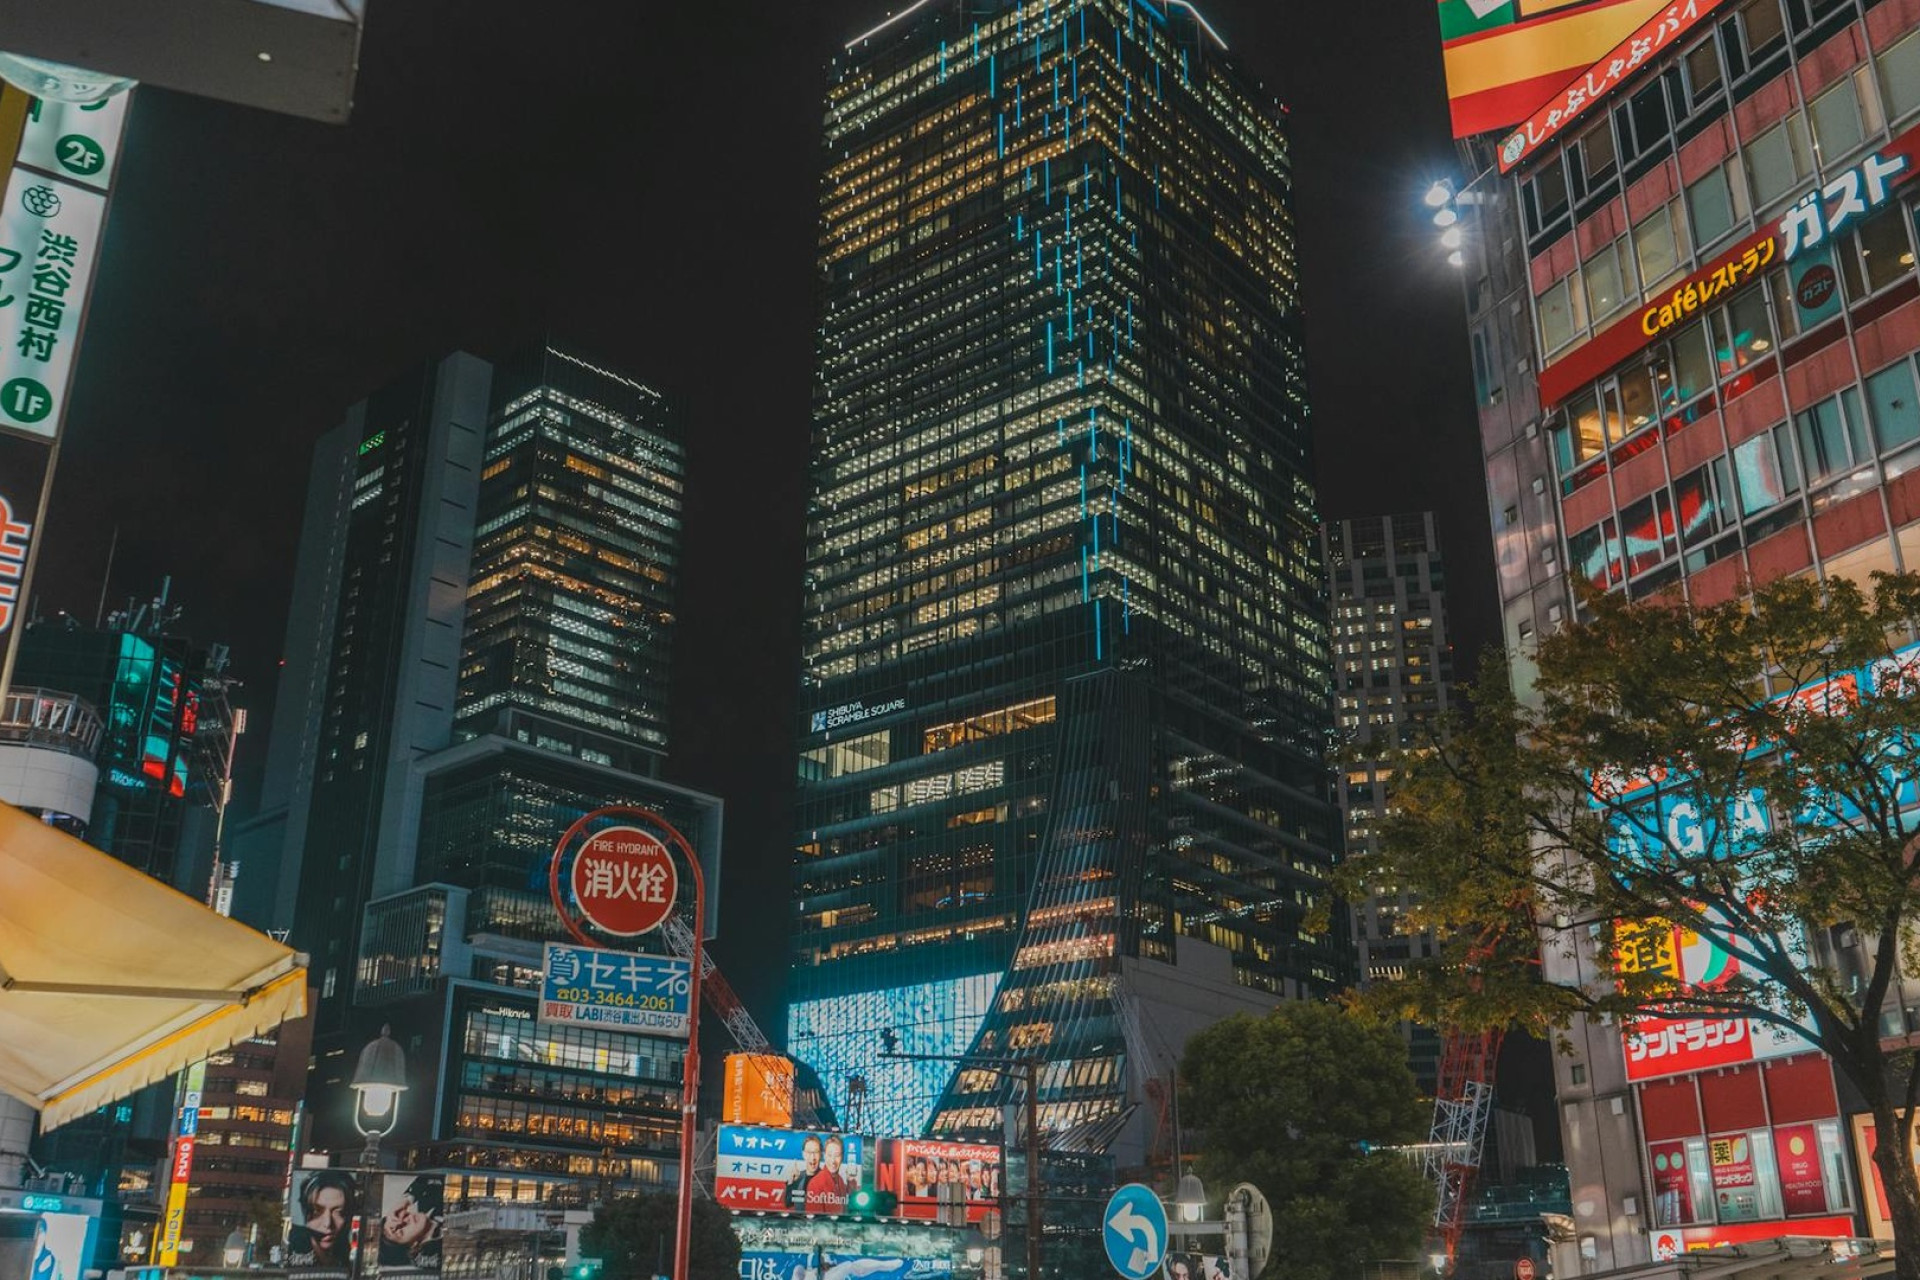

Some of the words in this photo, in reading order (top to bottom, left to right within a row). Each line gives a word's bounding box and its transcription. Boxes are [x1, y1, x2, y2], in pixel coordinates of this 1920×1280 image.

[63, 140, 98, 169] 2F
[1779, 154, 1906, 262] ガスト
[17, 229, 78, 363] 渋谷西村
[14, 384, 44, 416] 1F
[828, 702, 862, 717] SHIBUYA
[828, 709, 870, 728] SCRAMBLE
[870, 698, 905, 717] SQUARE
[593, 841, 614, 852] FIRE
[616, 843, 660, 856] HYDRANT
[584, 858, 668, 903] 消火栓
[584, 953, 689, 996] セキネ
[545, 1004, 574, 1019] 買取
[569, 988, 675, 1012] 03-3464-2061
[1627, 1017, 1746, 1062] サンドラッグ
[1714, 1141, 1731, 1163] 薬
[731, 1161, 785, 1175] オドロク
